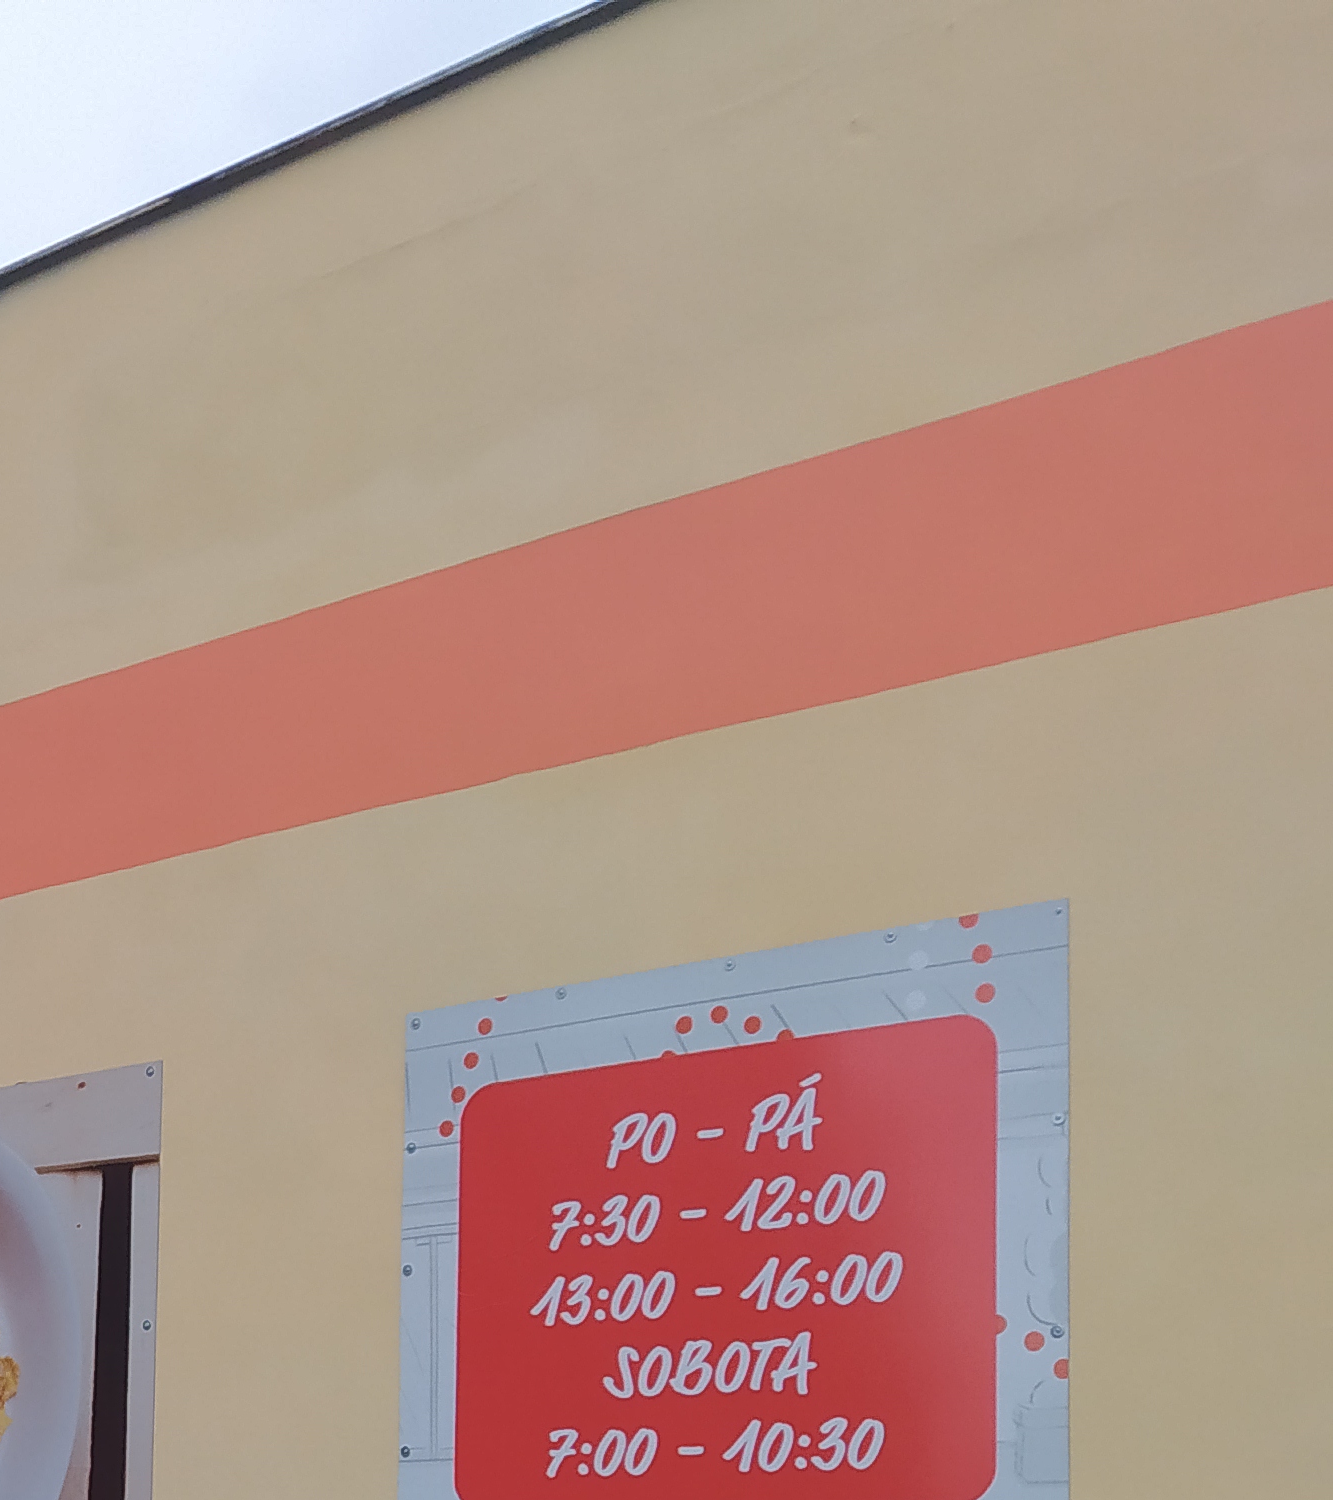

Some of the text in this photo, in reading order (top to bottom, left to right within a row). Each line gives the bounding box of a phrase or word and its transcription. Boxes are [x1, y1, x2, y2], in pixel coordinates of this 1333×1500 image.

[606, 1112, 677, 1169] PO
[745, 1072, 823, 1152] PÁ
[548, 1194, 661, 1252] 7:30
[724, 1169, 886, 1232] 12:00
[529, 1270, 676, 1327] 13:00
[739, 1250, 904, 1311] 16:00
[602, 1330, 818, 1399] SOBOTA
[545, 1427, 659, 1478] 7:00
[722, 1416, 885, 1473] 10:30
